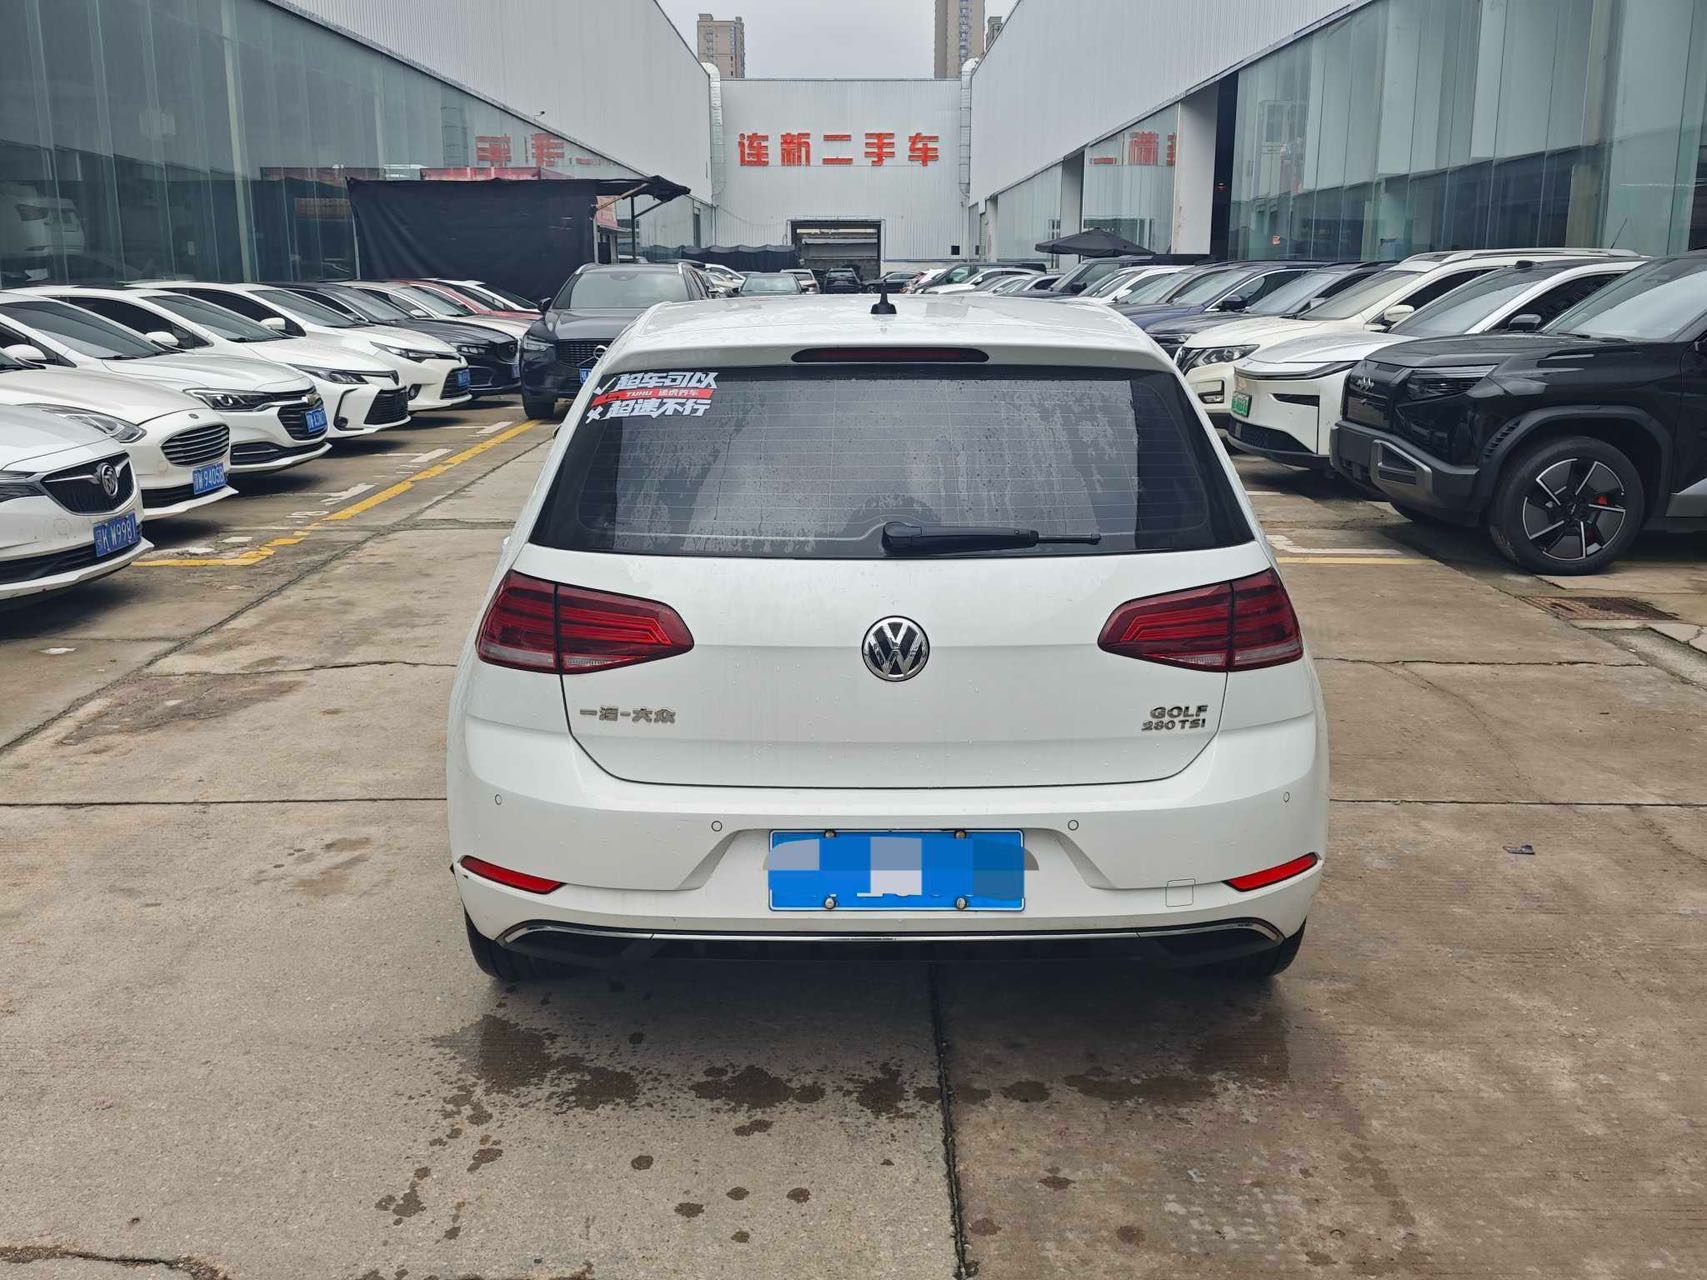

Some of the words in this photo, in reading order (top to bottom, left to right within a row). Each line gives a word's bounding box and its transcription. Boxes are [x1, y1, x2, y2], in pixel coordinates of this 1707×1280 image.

[738, 132, 939, 166] 连新二手车
[611, 371, 718, 391] 超车可以
[603, 398, 712, 419] 超速不行
[1150, 705, 1208, 719] GOLF
